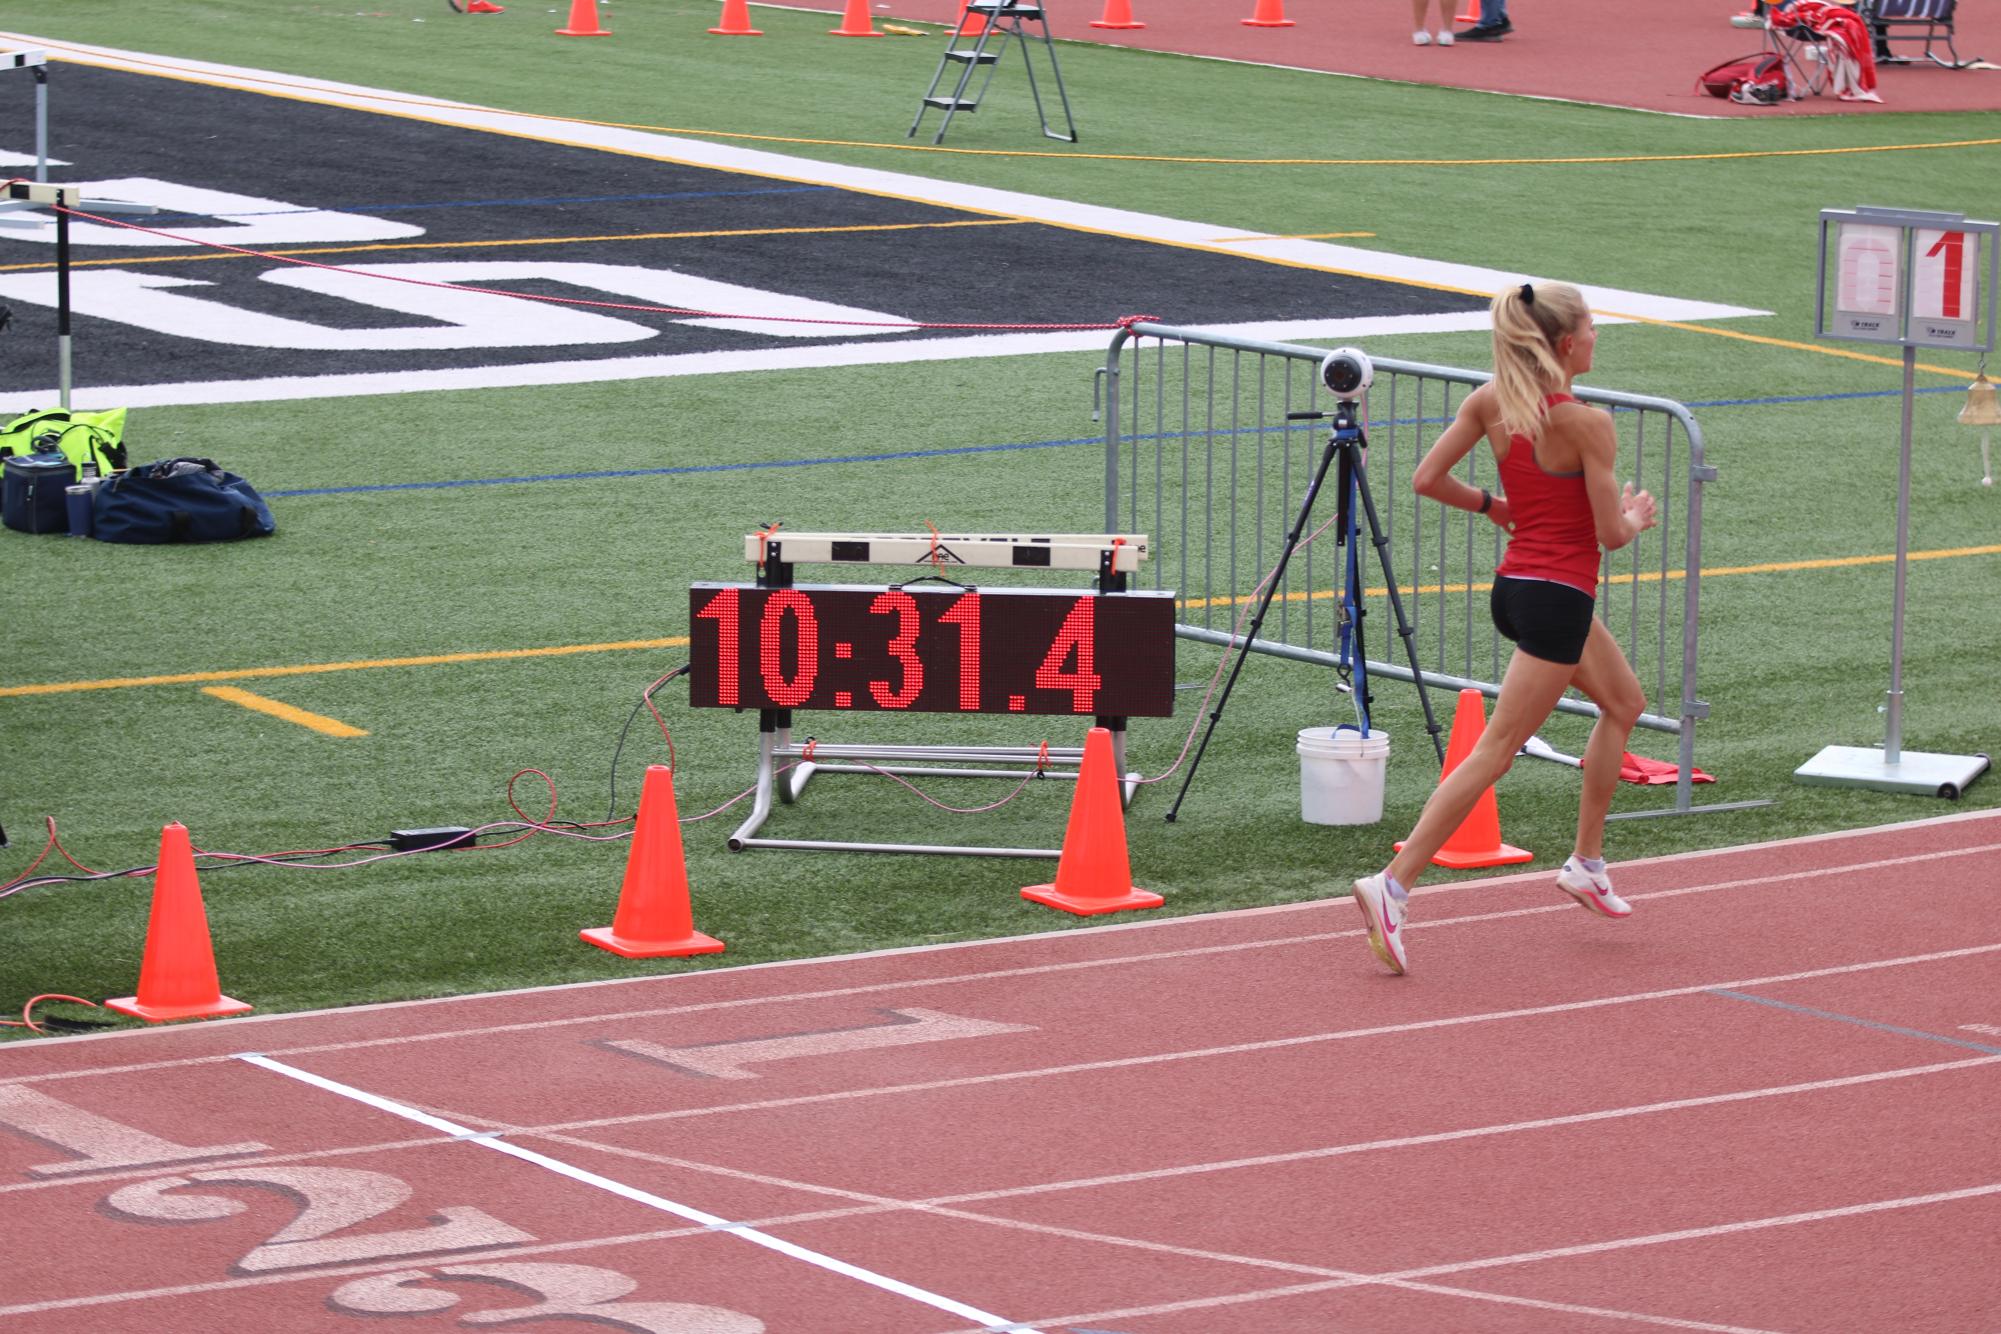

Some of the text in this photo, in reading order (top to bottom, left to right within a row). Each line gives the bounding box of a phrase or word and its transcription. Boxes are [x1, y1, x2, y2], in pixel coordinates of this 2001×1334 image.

[1926, 231, 1965, 318] 1
[696, 588, 1101, 712] 10:31.4
[96, 1166, 540, 1277] 2
